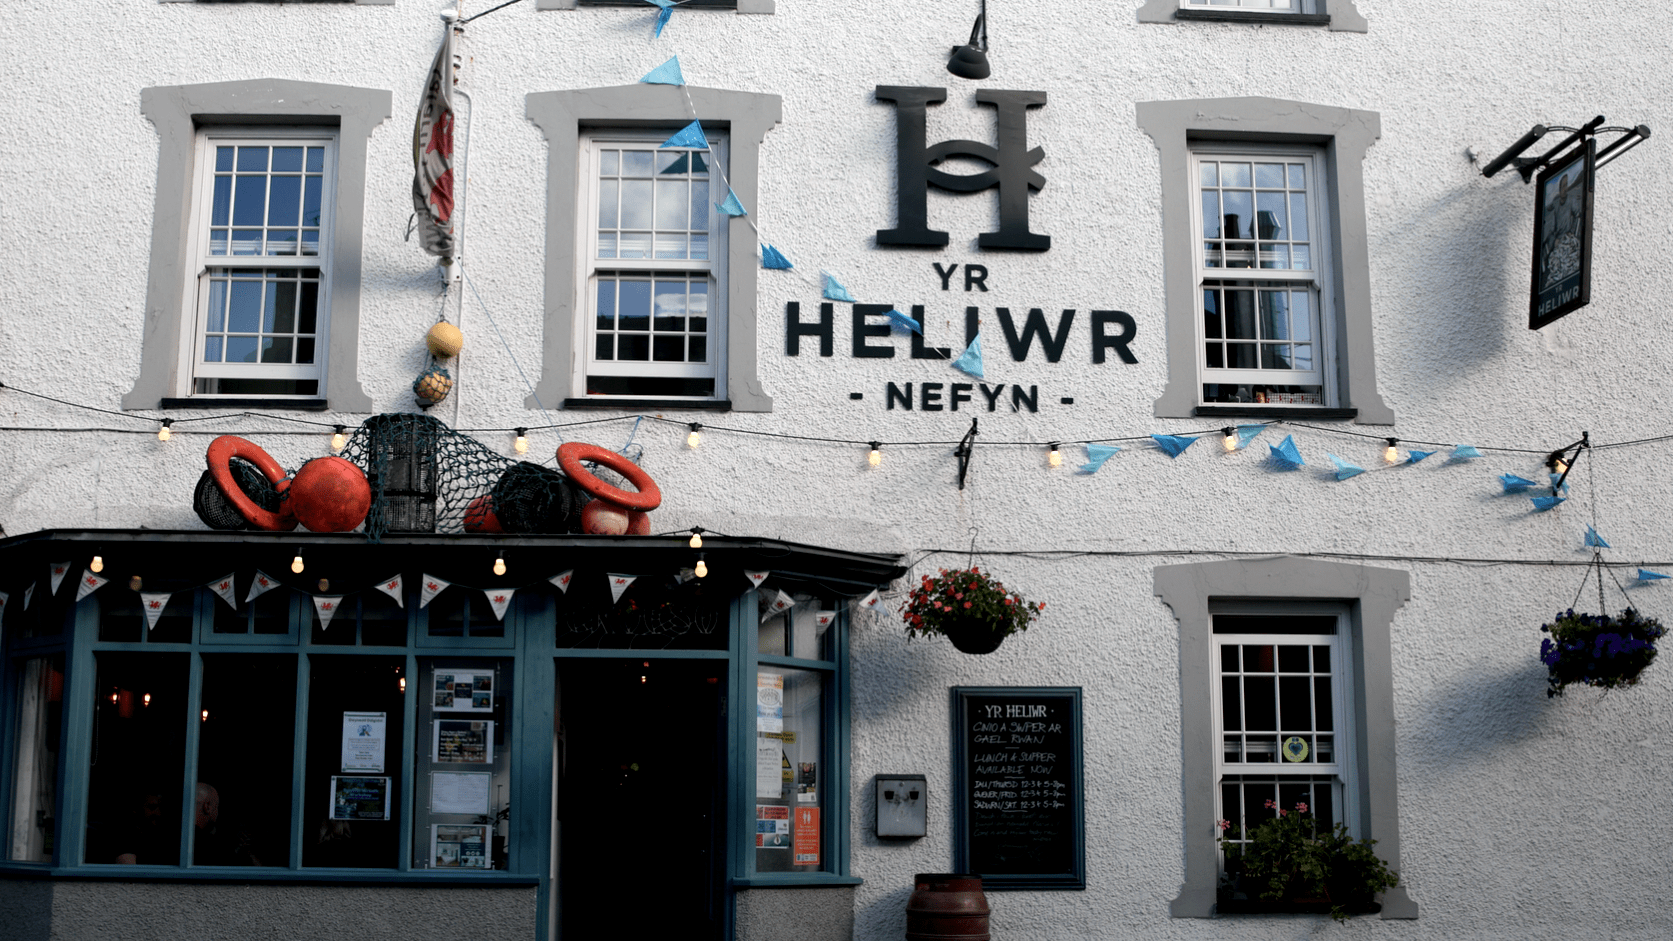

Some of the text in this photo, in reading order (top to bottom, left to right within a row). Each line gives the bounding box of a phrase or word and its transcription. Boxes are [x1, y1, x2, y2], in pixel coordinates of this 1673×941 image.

[932, 262, 989, 292] YR
[1538, 285, 1579, 317] HELIWR
[784, 301, 1139, 364] HELIWR
[886, 381, 1039, 413] NEFYN
[984, 704, 1047, 718] YR HELIWR
[999, 722, 1007, 733] A
[1008, 721, 1047, 733] SWPER
[1048, 722, 1062, 734] AR
[973, 734, 1045, 744] GAEL RWAN
[974, 752, 1008, 763] LUNCH
[1018, 751, 1057, 763] SUPPER
[975, 765, 1054, 775] AVAILABLE NOW
